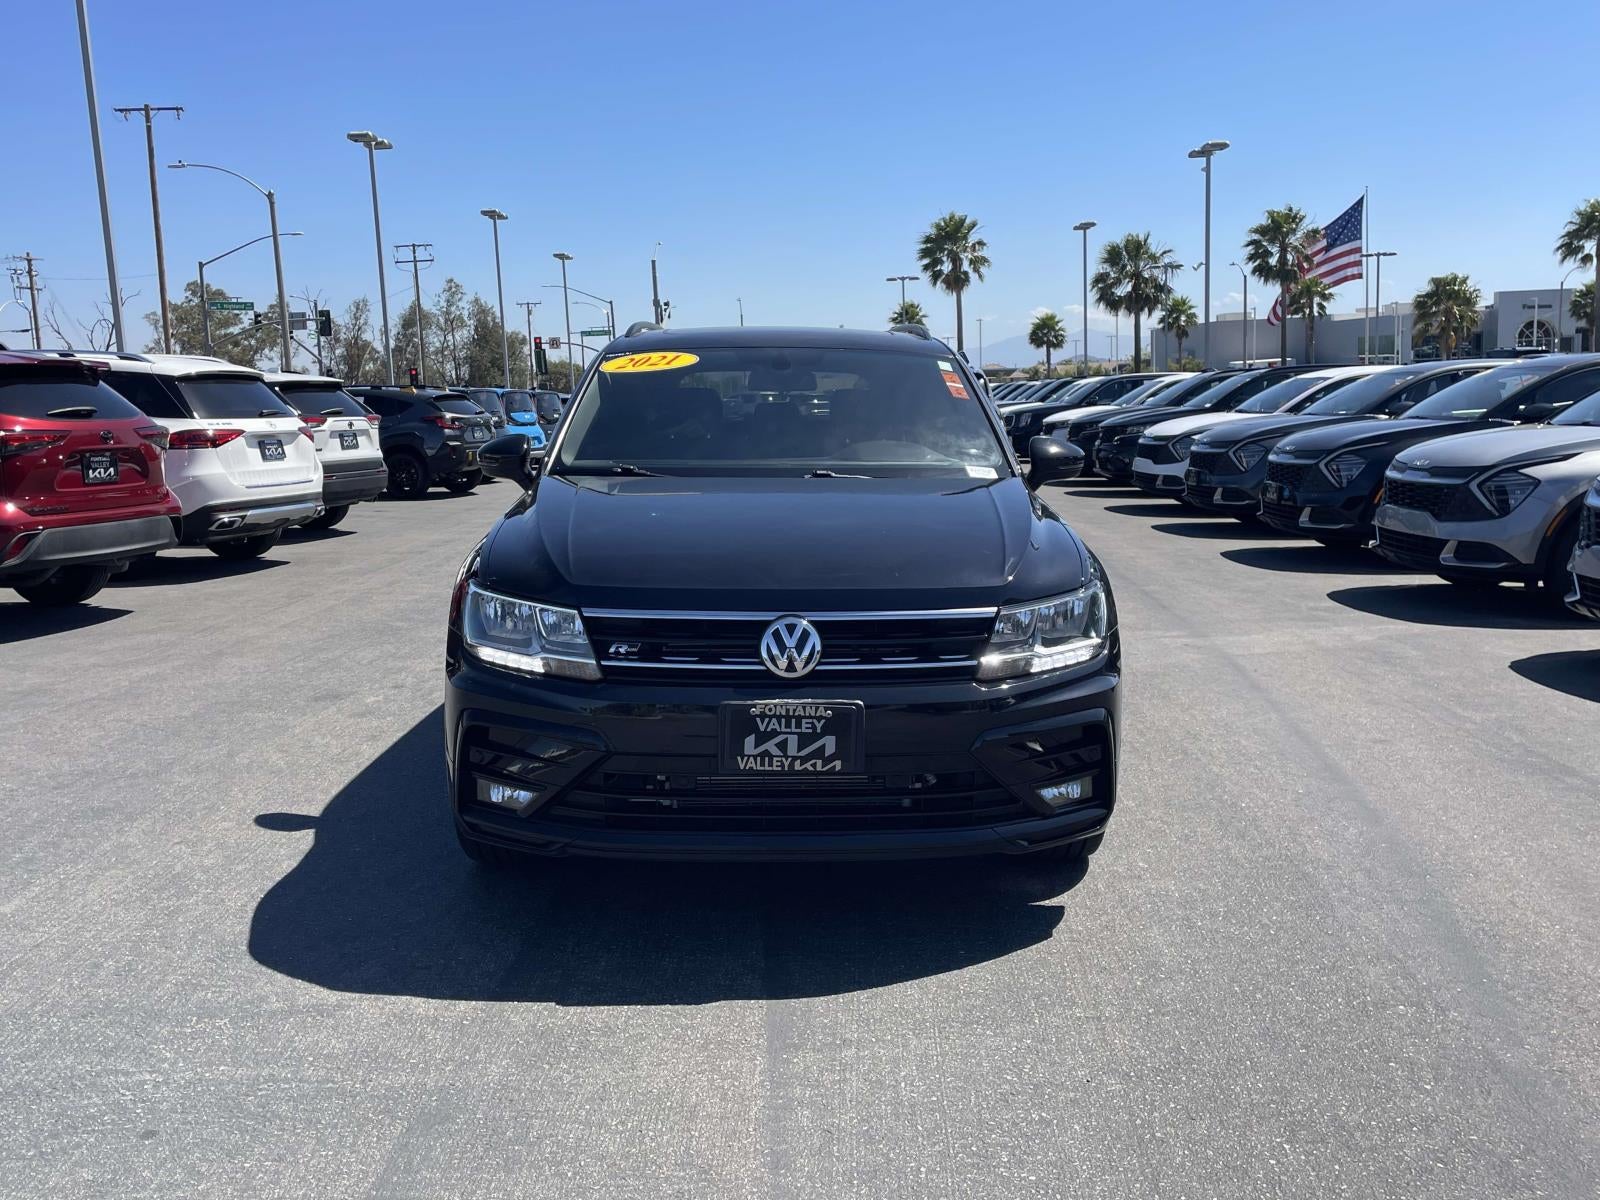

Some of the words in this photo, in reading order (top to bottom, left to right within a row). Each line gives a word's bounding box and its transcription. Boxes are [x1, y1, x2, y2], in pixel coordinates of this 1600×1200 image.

[616, 354, 682, 370] 2021
[89, 467, 115, 478] KIA
[756, 704, 826, 717] FONTANA
[756, 718, 825, 732] VALLEY
[744, 734, 836, 757] KIA
[737, 756, 792, 771] VALLEY
[794, 759, 842, 772] KIA
